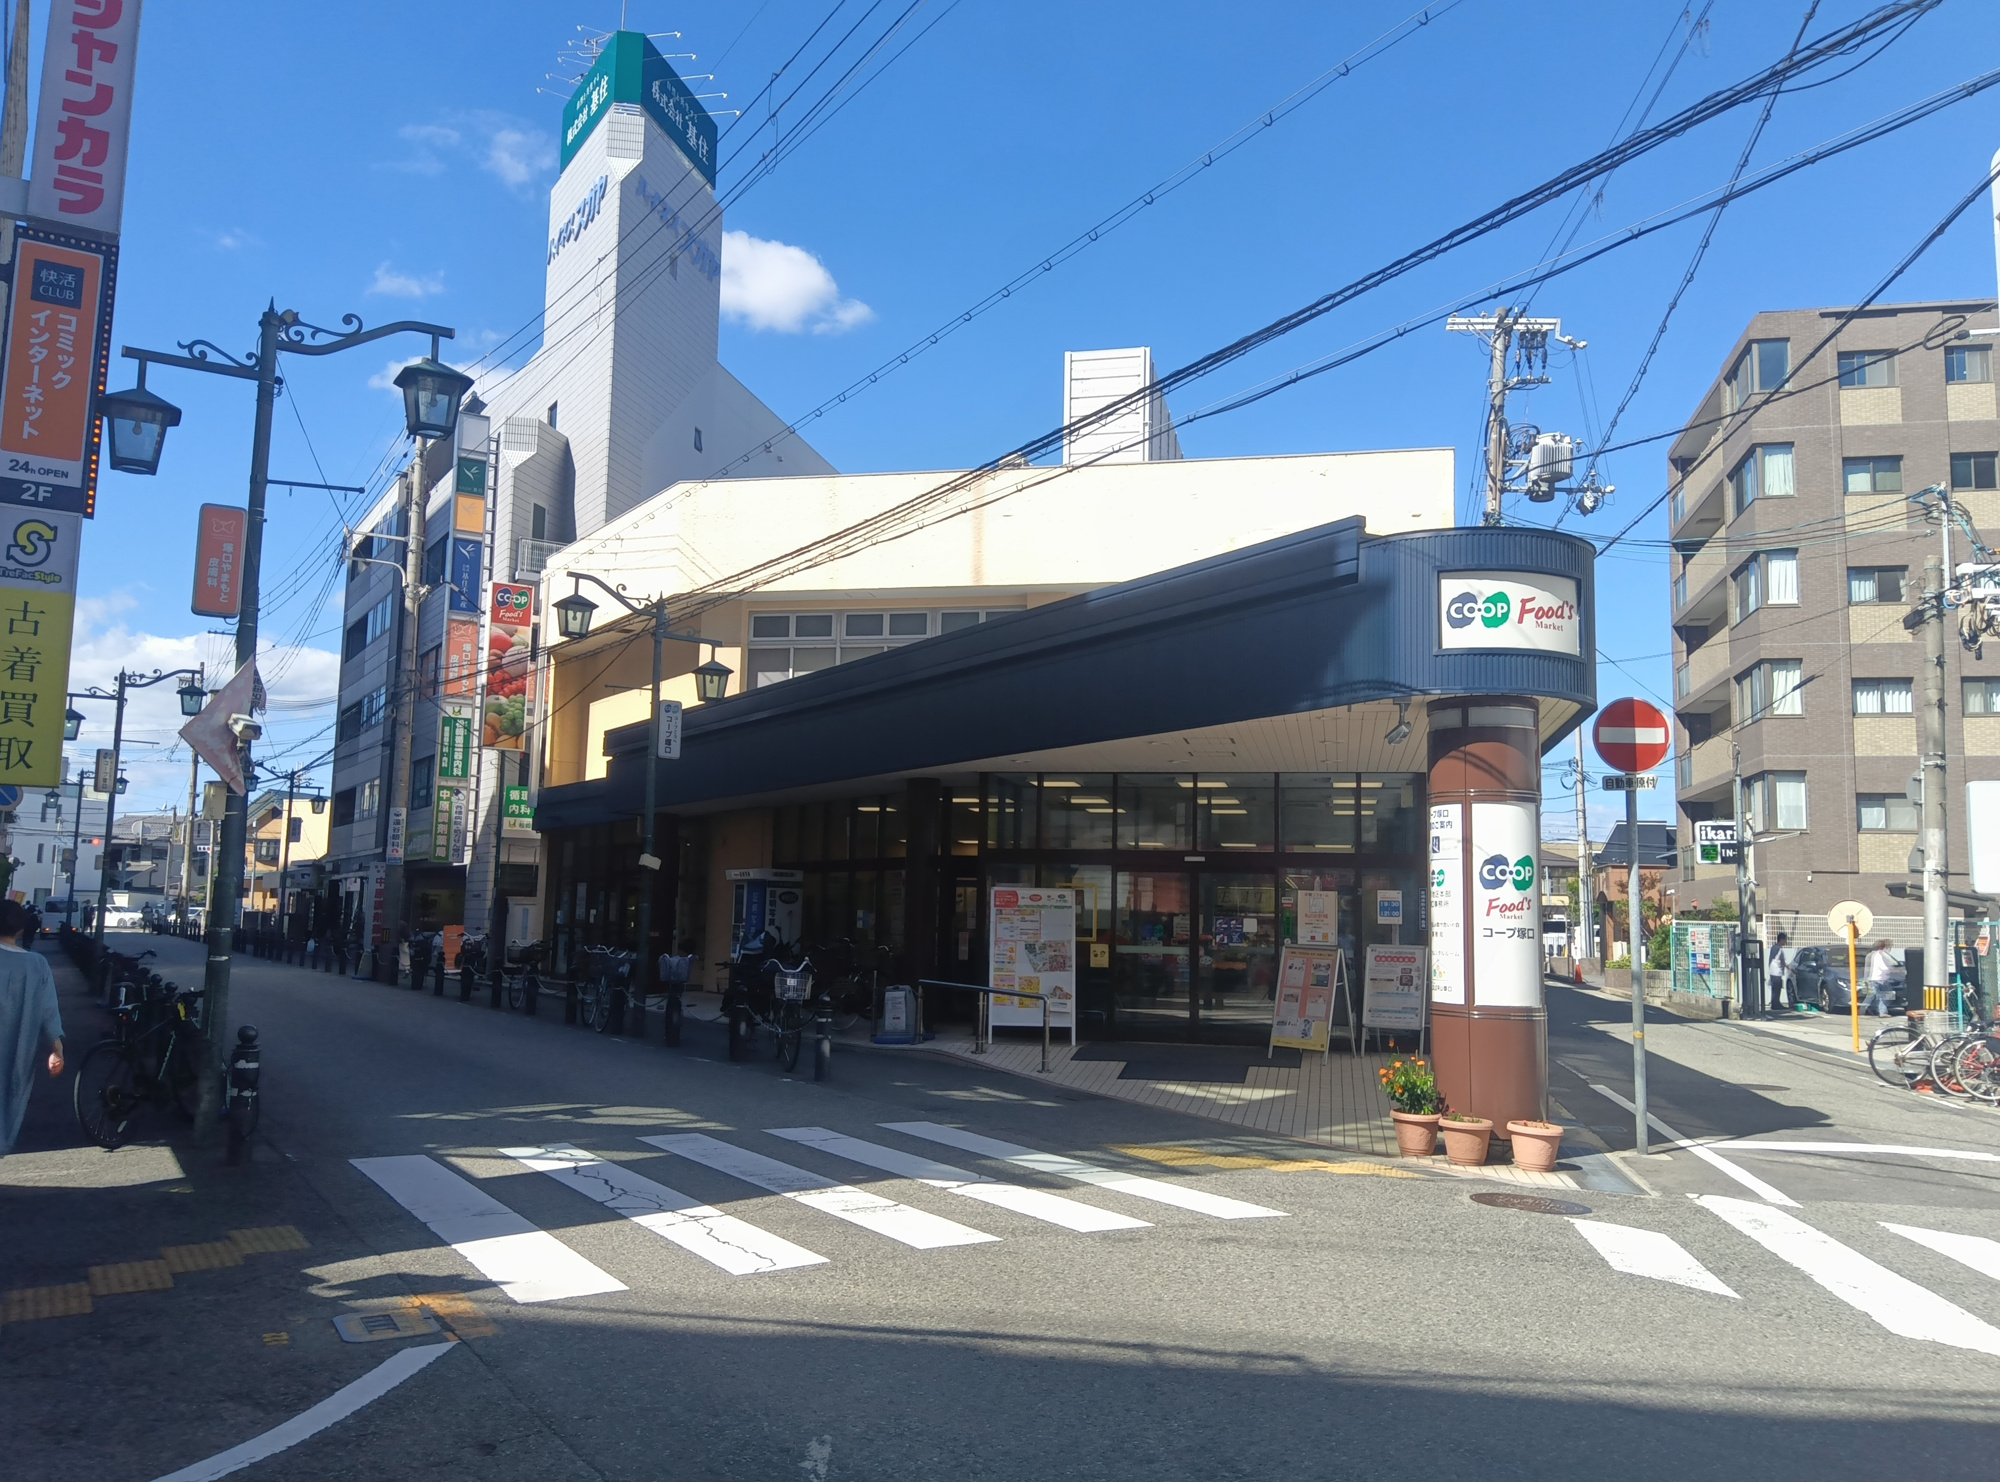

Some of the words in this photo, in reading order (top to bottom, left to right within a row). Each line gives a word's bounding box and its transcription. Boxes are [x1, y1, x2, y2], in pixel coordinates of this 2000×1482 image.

[40, 267, 76, 289] 快活
[39, 284, 75, 301] CLUB
[51, 312, 78, 390] コミック
[21, 309, 52, 440] インターネット
[37, 467, 69, 480] OPEN
[20, 482, 53, 503] 2F
[219, 542, 234, 603] 塚口やまもと
[498, 609, 524, 619] Food's
[1517, 596, 1574, 625] Food's
[1535, 620, 1564, 632] Market
[0, 600, 46, 771] 古着買取
[508, 803, 531, 815] 内科
[1700, 826, 1737, 840] ikari
[1485, 896, 1532, 917] Food's
[1482, 926, 1535, 941] コープ塚口
